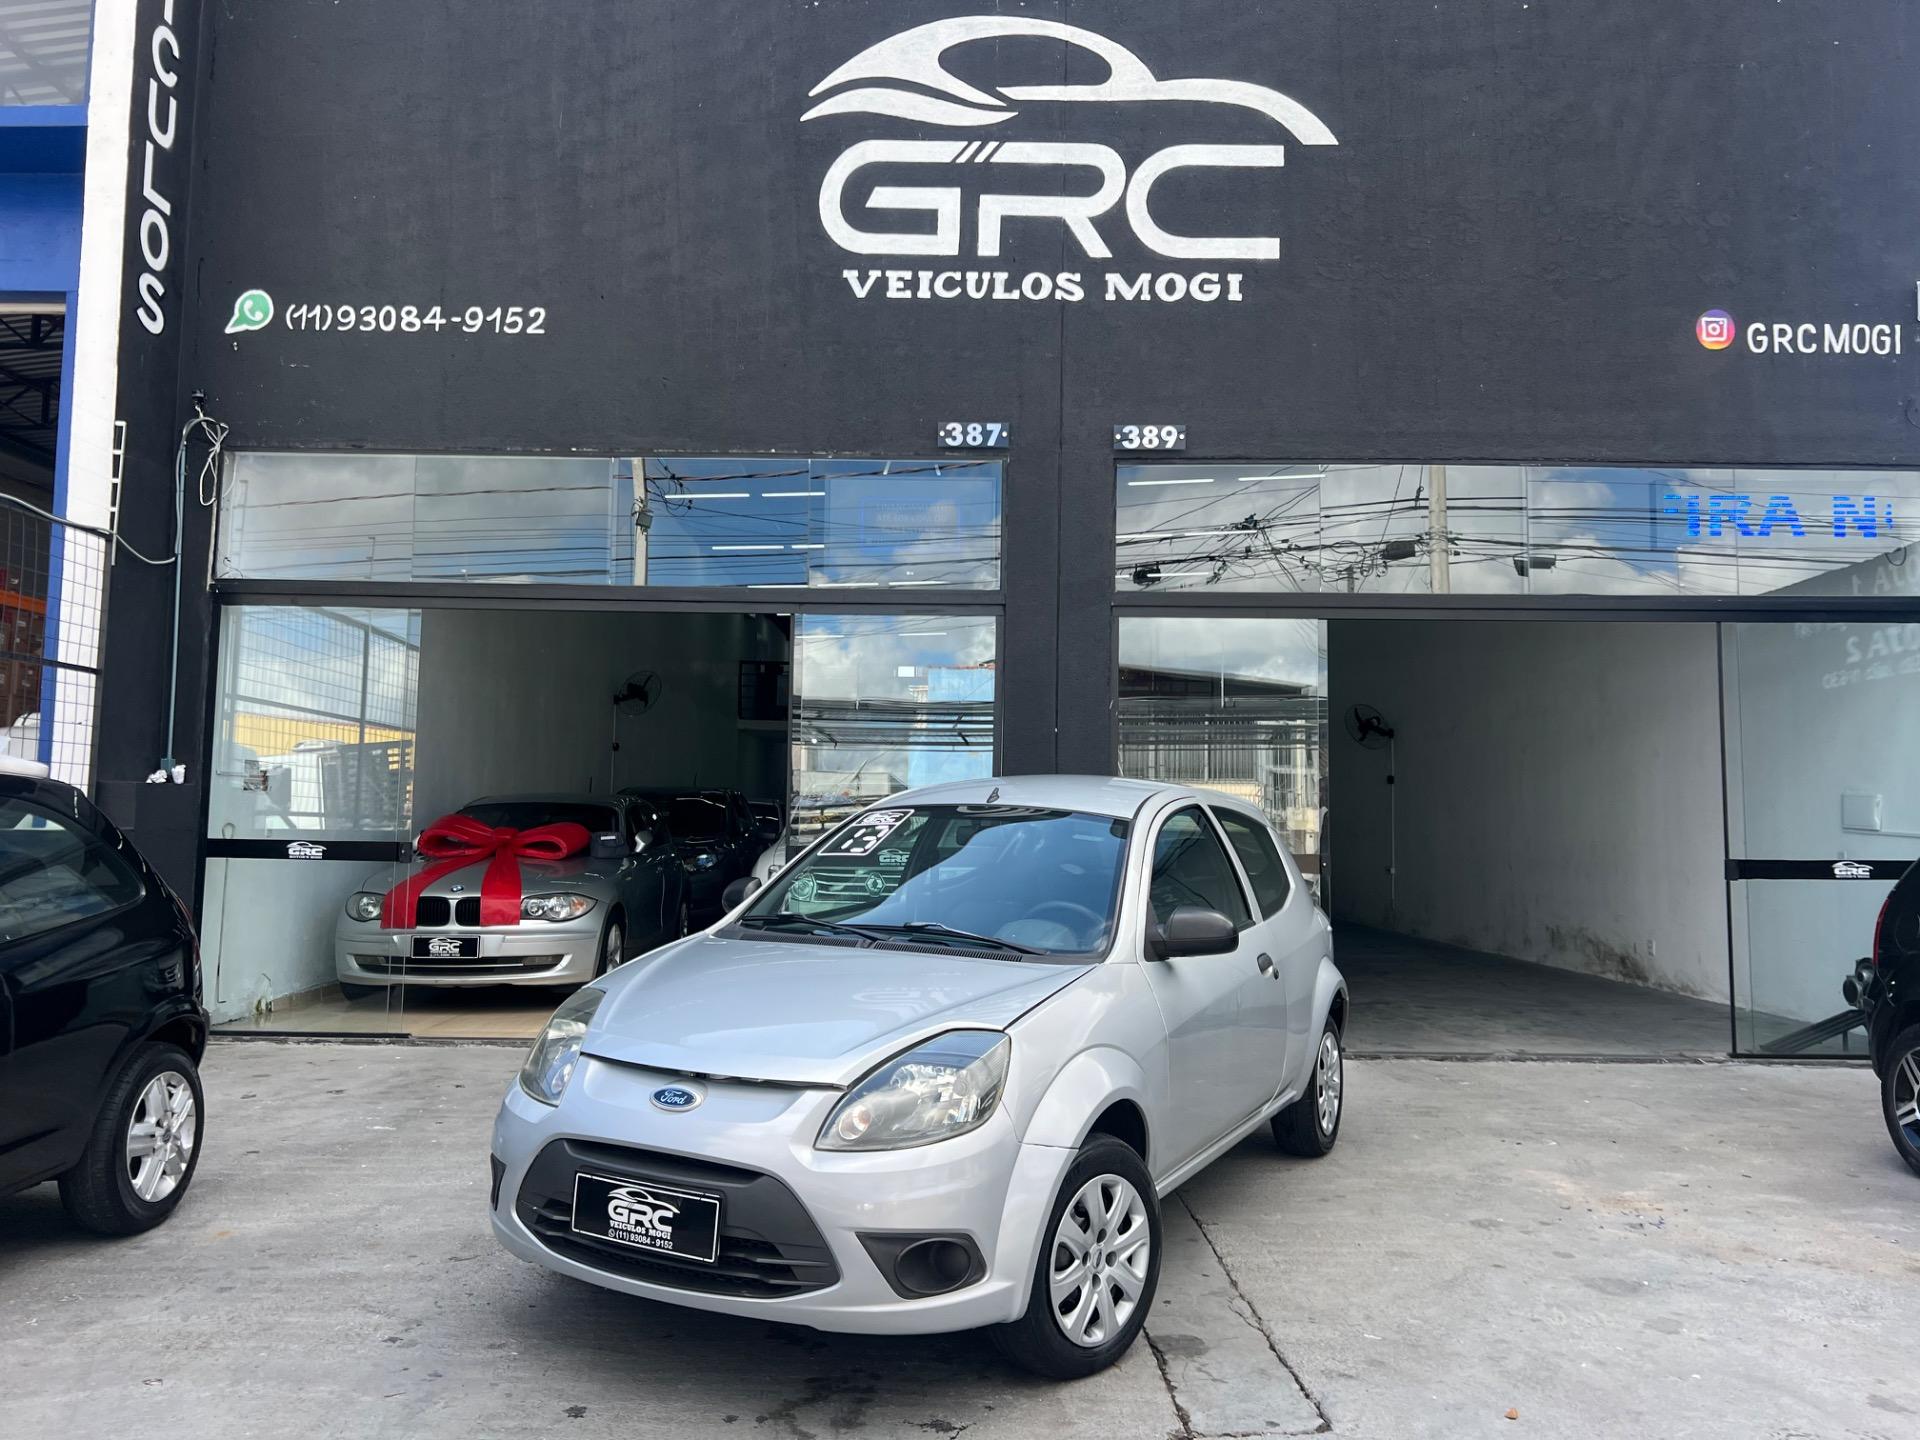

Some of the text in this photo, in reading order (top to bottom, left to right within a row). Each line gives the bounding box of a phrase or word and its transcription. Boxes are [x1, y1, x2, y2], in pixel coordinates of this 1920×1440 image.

[818, 139, 1285, 260] GRC
[842, 269, 1243, 302] VEICULOS MOGI
[286, 304, 546, 334] (11)93084-9152
[945, 422, 1002, 447] 387
[1122, 425, 1178, 449] 389
[841, 826, 889, 852] 13
[429, 942, 460, 952] GRC
[660, 1089, 688, 1104] Ford
[608, 1199, 673, 1233] GRC
[609, 1220, 671, 1240] VEICULOS MOGI
